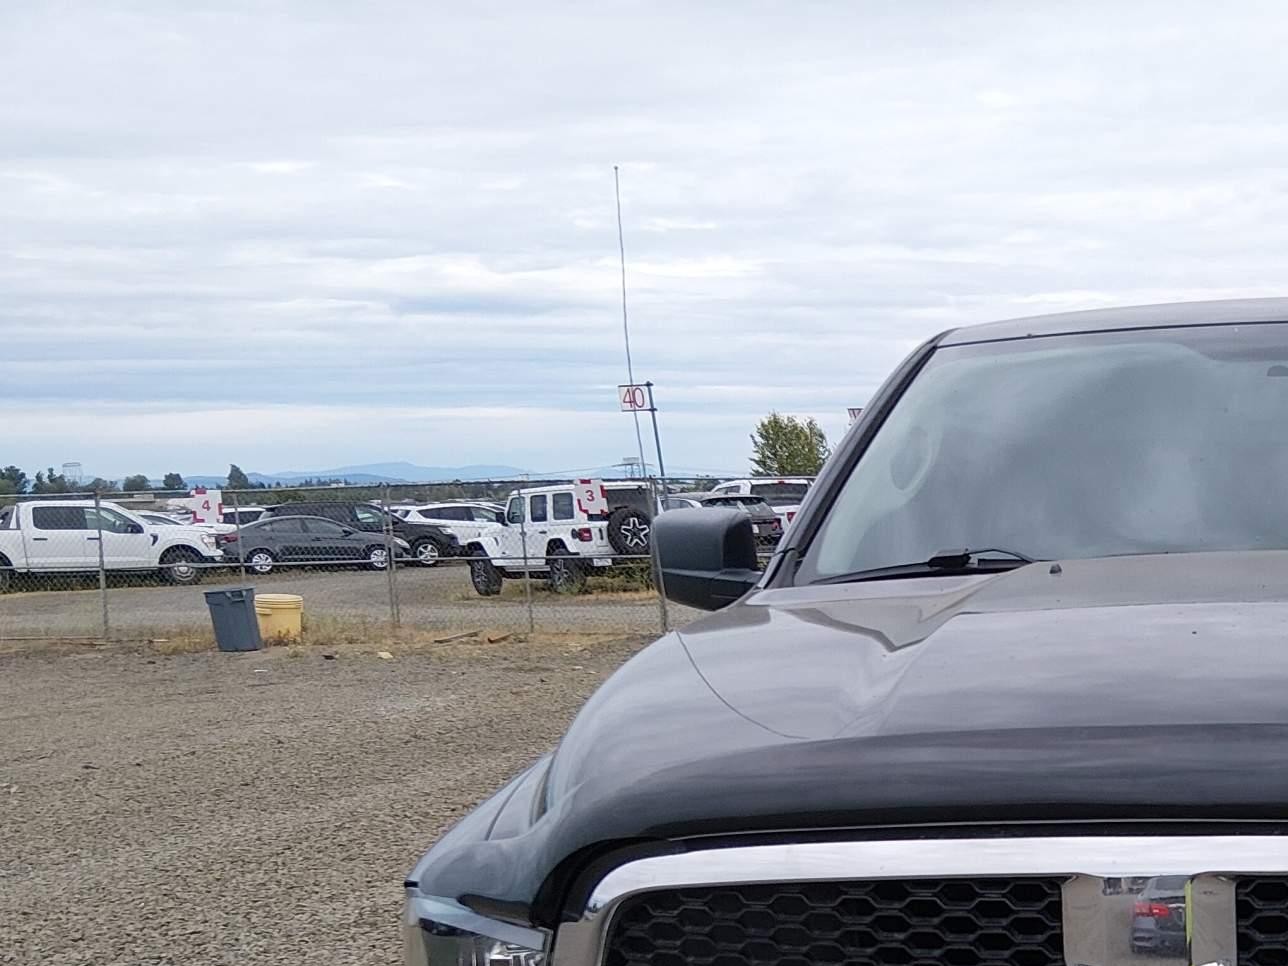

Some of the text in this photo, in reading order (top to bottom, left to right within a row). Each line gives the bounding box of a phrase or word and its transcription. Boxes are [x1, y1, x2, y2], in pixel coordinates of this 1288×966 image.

[622, 387, 645, 409] 40
[585, 489, 595, 502] 3
[201, 499, 211, 511] 4
